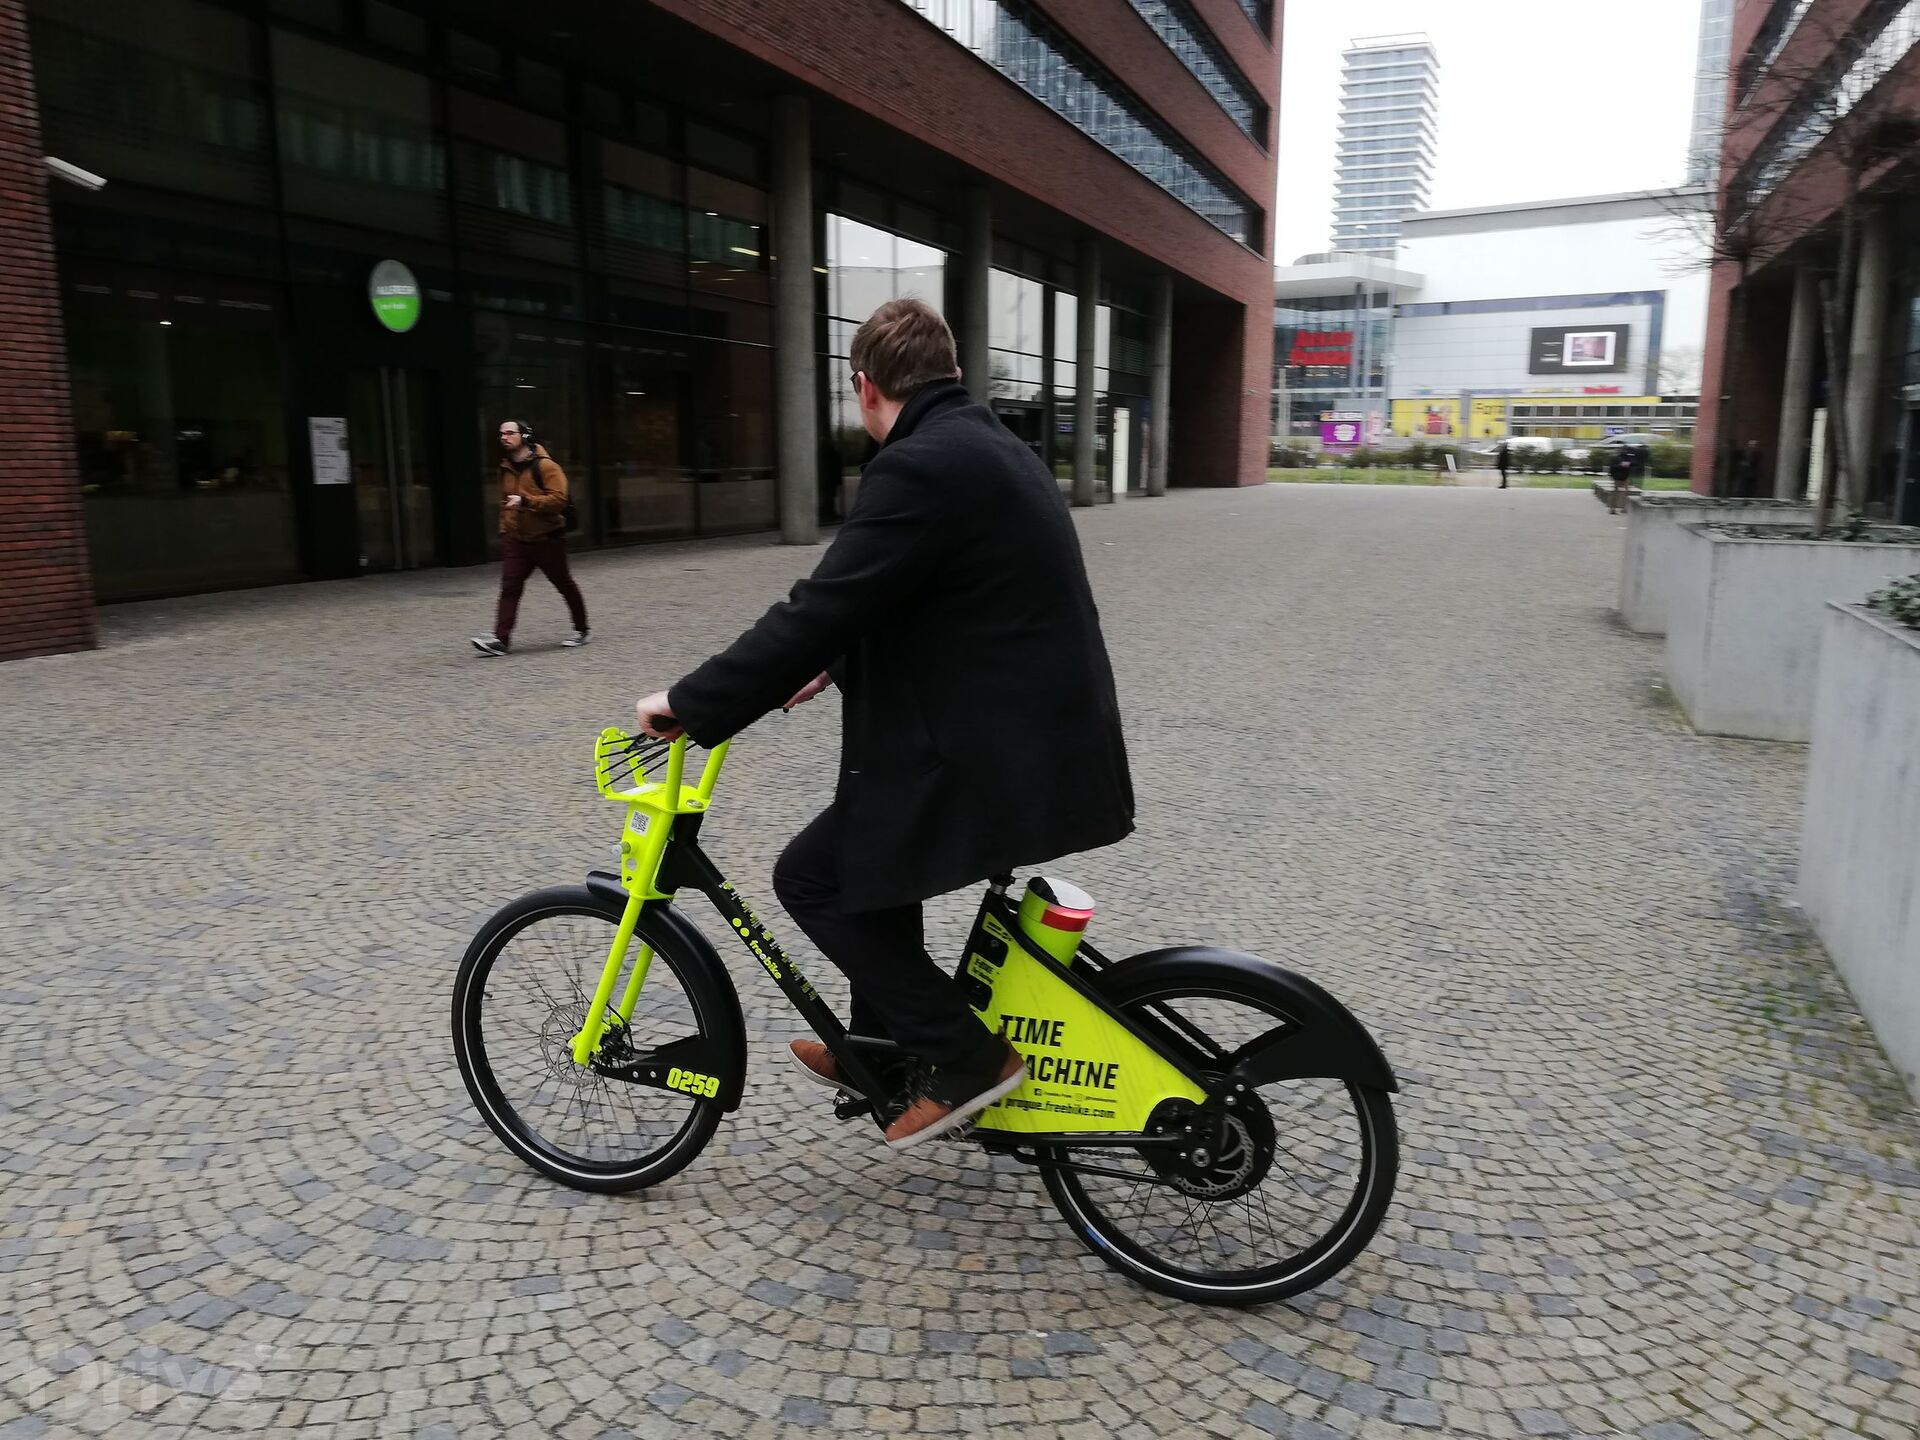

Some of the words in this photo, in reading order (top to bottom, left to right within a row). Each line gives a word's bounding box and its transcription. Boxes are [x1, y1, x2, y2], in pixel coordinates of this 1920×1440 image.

[749, 939, 782, 980] freebike
[1000, 1014, 1065, 1047] TIME
[666, 1067, 720, 1098] 0259
[1025, 1054, 1119, 1090] ACHINE
[1005, 1098, 1116, 1119] prague.freebike.com
